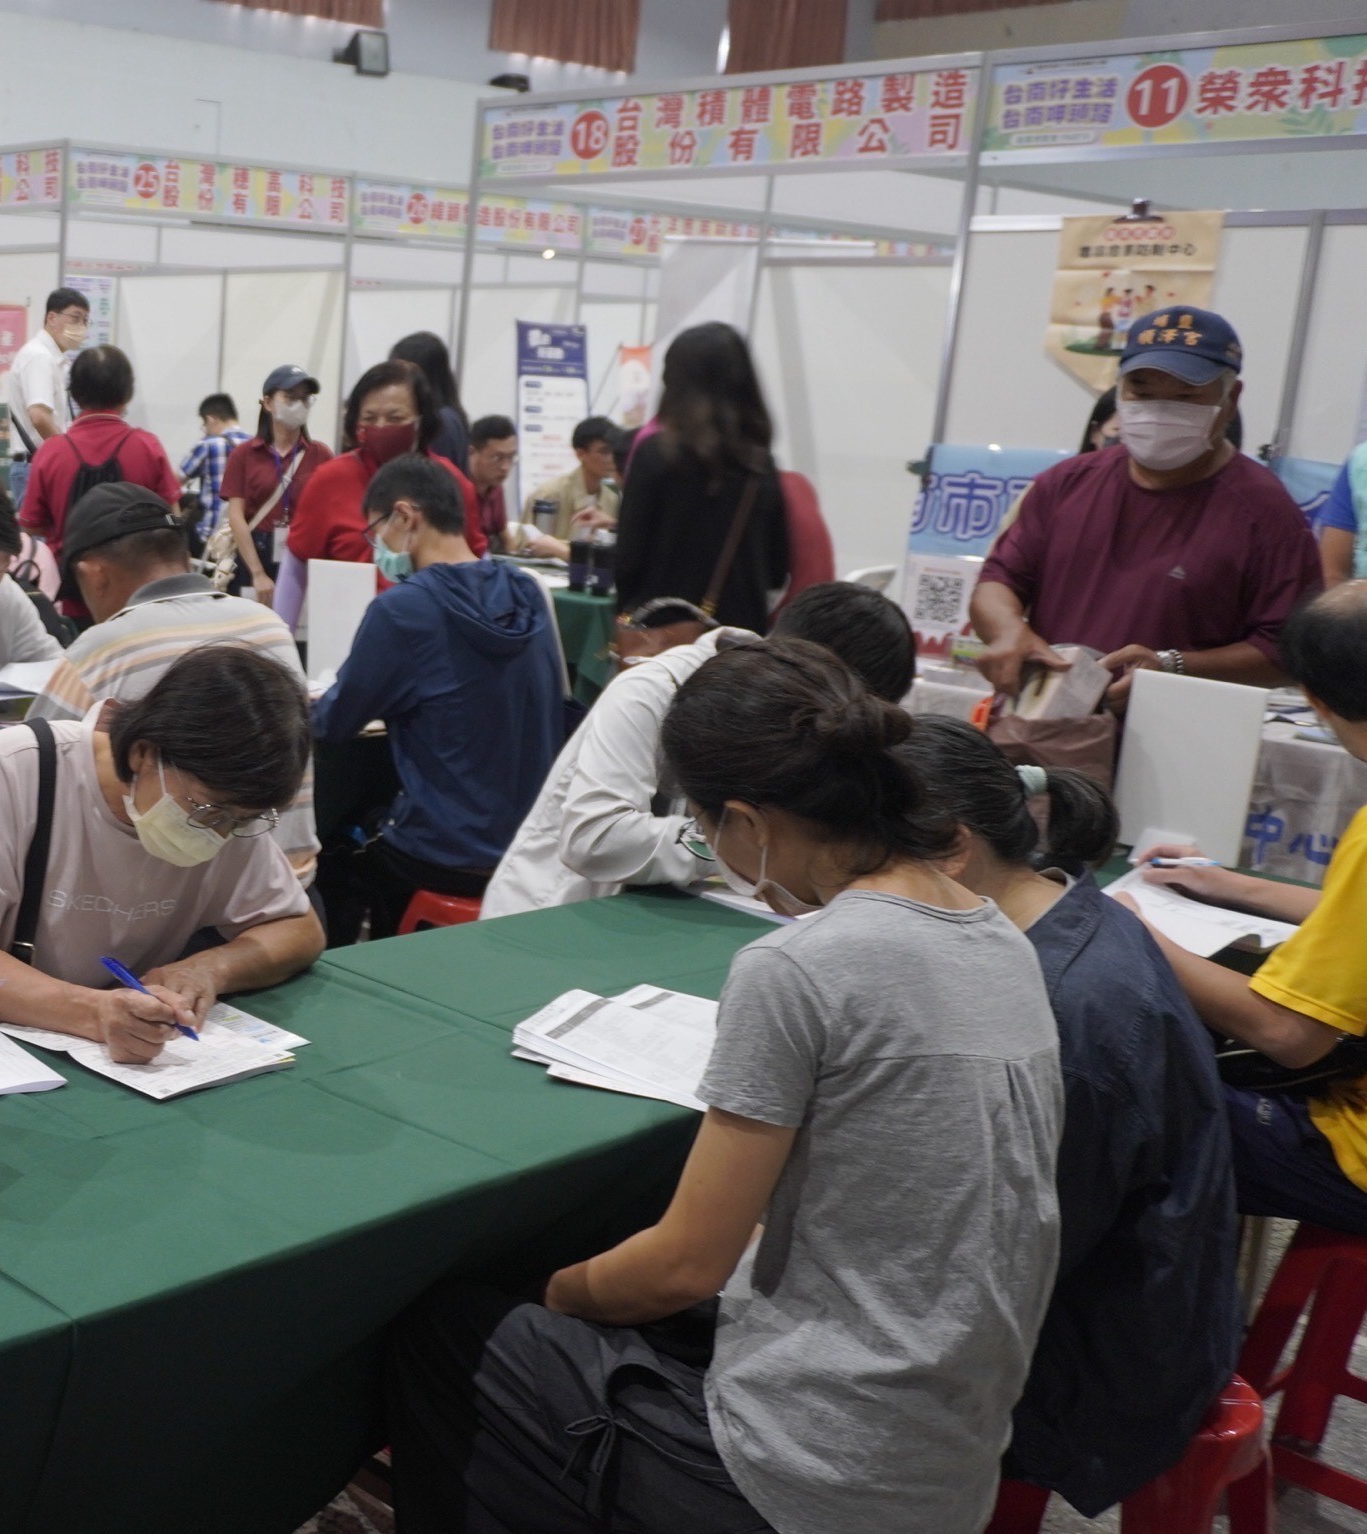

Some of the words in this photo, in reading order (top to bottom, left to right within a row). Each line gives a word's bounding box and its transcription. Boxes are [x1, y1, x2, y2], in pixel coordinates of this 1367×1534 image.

[616, 69, 967, 131] 台灣積體電路製造
[1134, 76, 1181, 116] 11
[575, 119, 607, 152] 18
[611, 113, 961, 168] 股份有限公司
[136, 170, 159, 194] 25
[163, 185, 344, 223] 股份有限公司
[49, 889, 177, 922] SKECHERS
